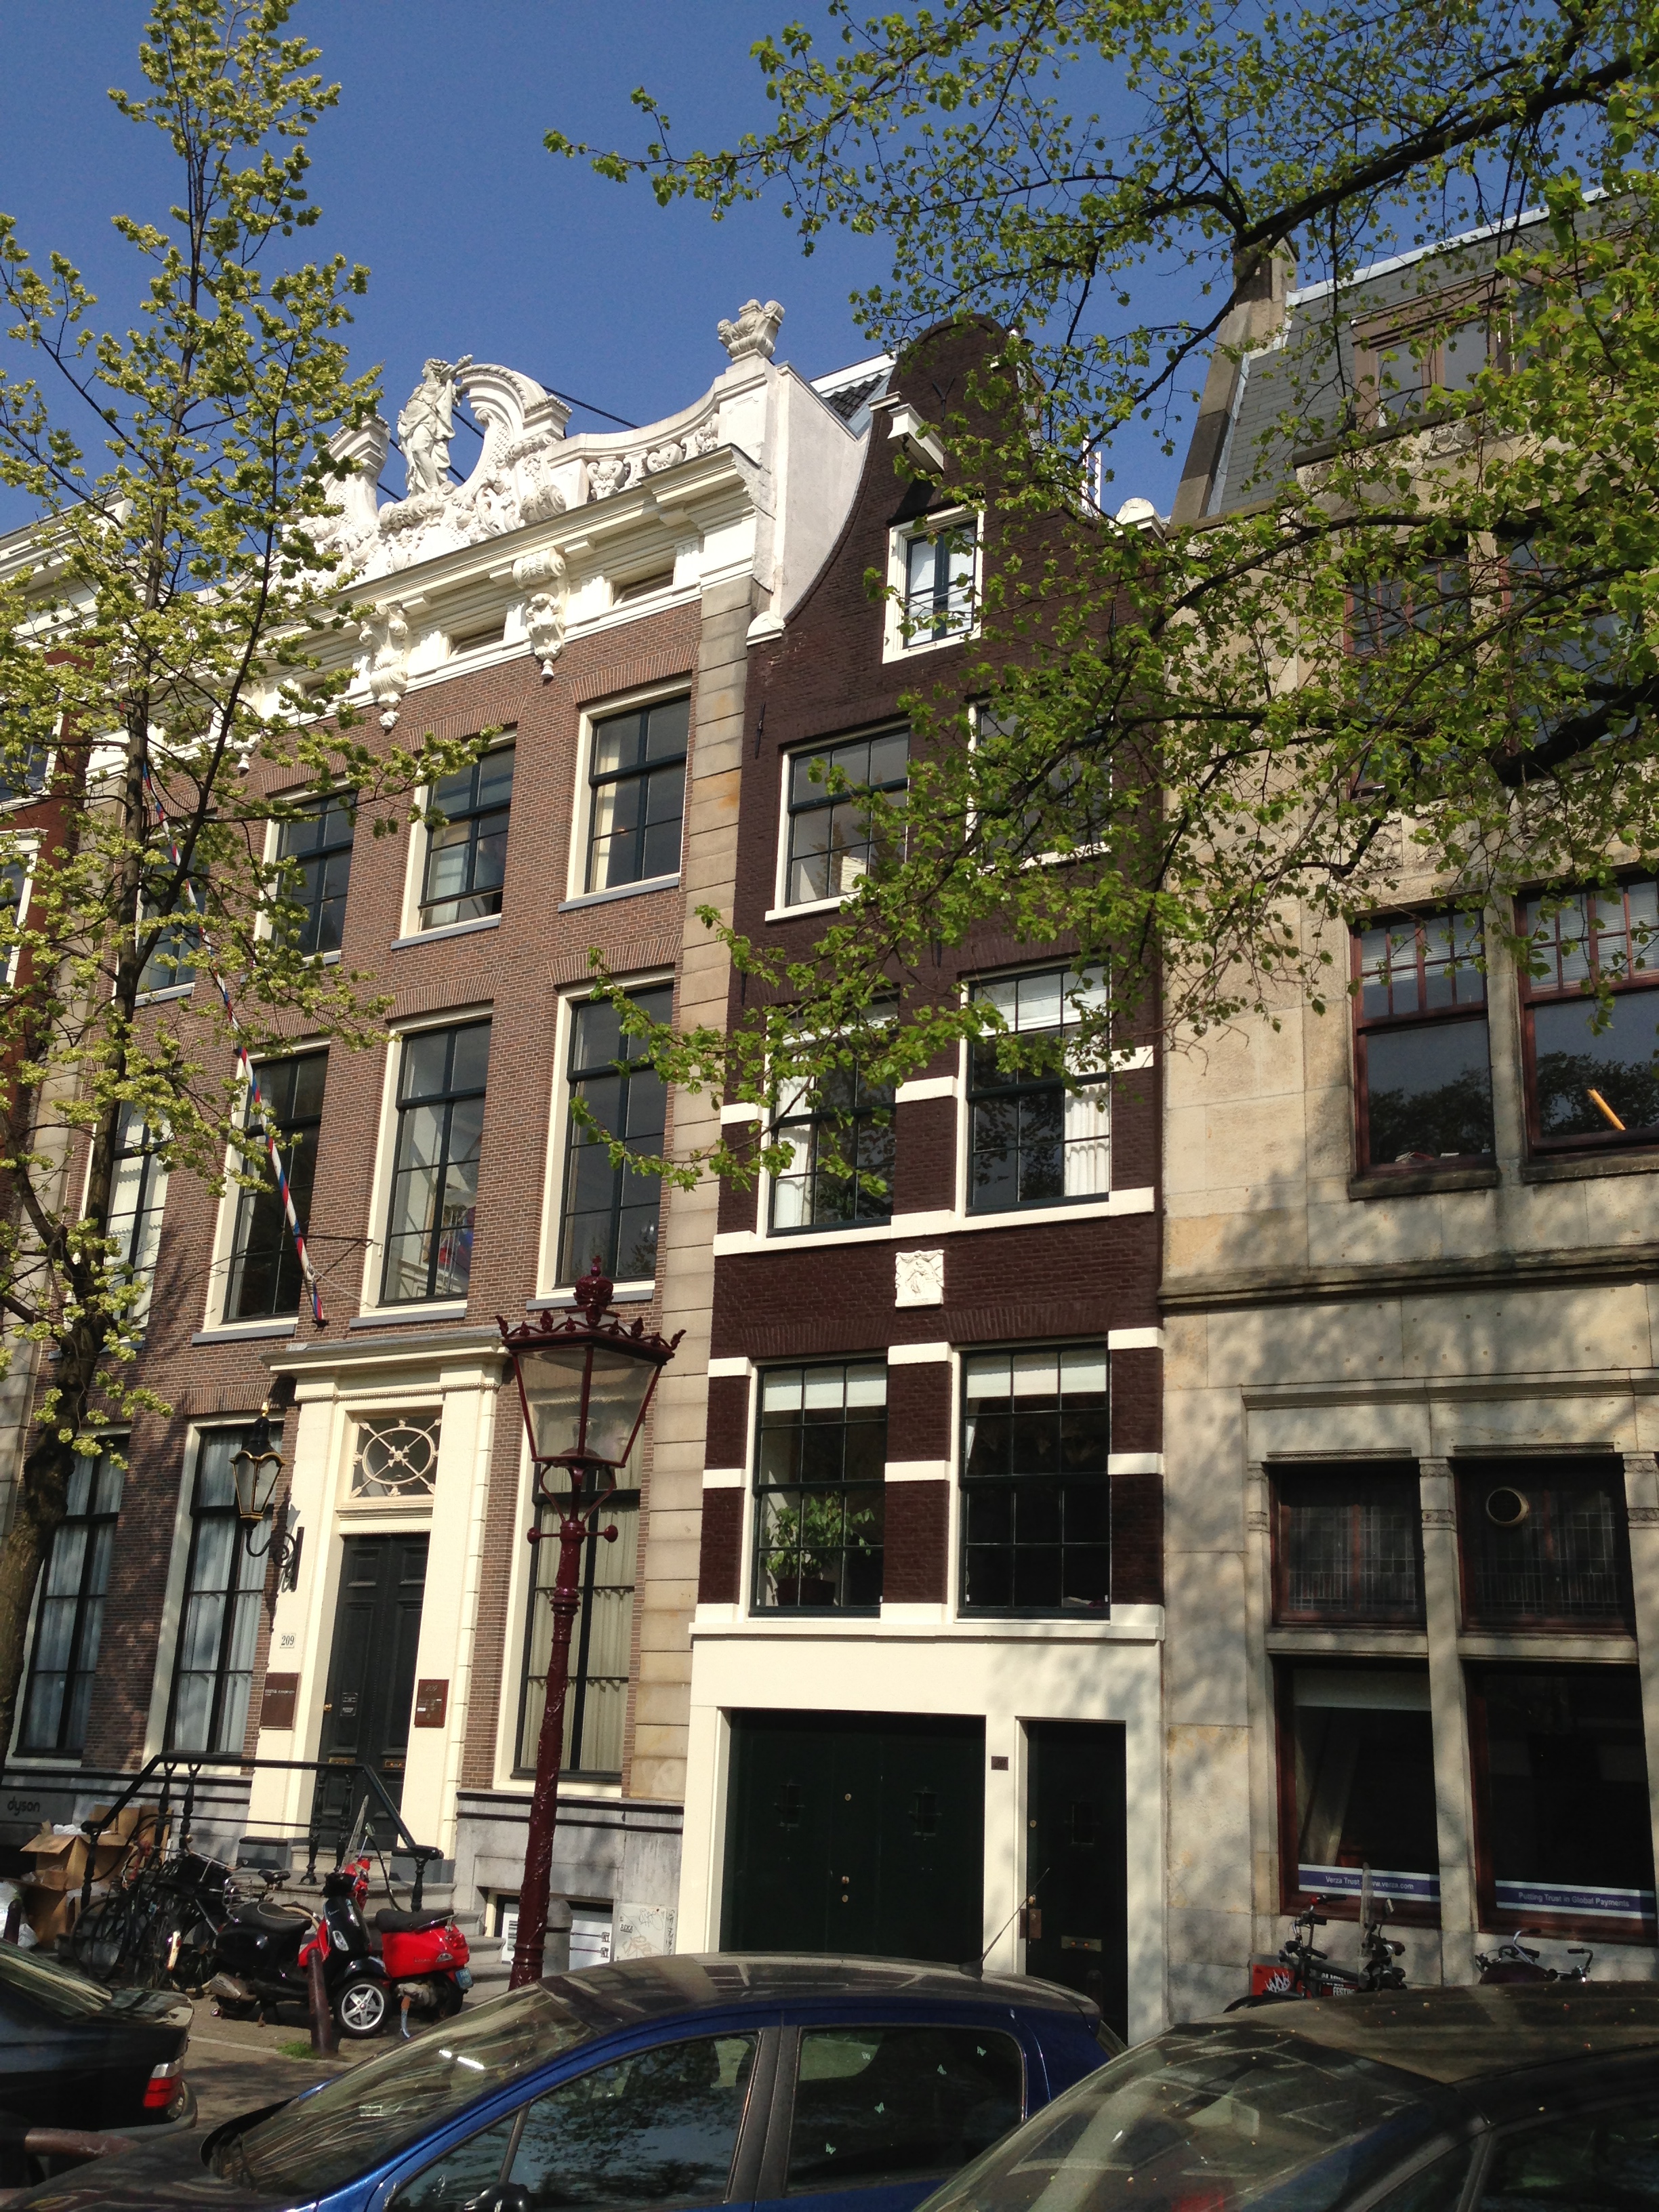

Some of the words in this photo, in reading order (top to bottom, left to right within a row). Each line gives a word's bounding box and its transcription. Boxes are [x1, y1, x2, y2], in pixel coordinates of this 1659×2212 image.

[281, 1635, 295, 1646] 209
[7, 1796, 41, 1816] dyson
[1326, 1876, 1343, 1884] Verza
[1344, 1877, 1359, 1885] Trust
[1519, 1891, 1542, 1902] Putting
[1544, 1893, 1562, 1902] Trust
[1572, 1896, 1594, 1904] Global
[1595, 1898, 1629, 1906] Payments
